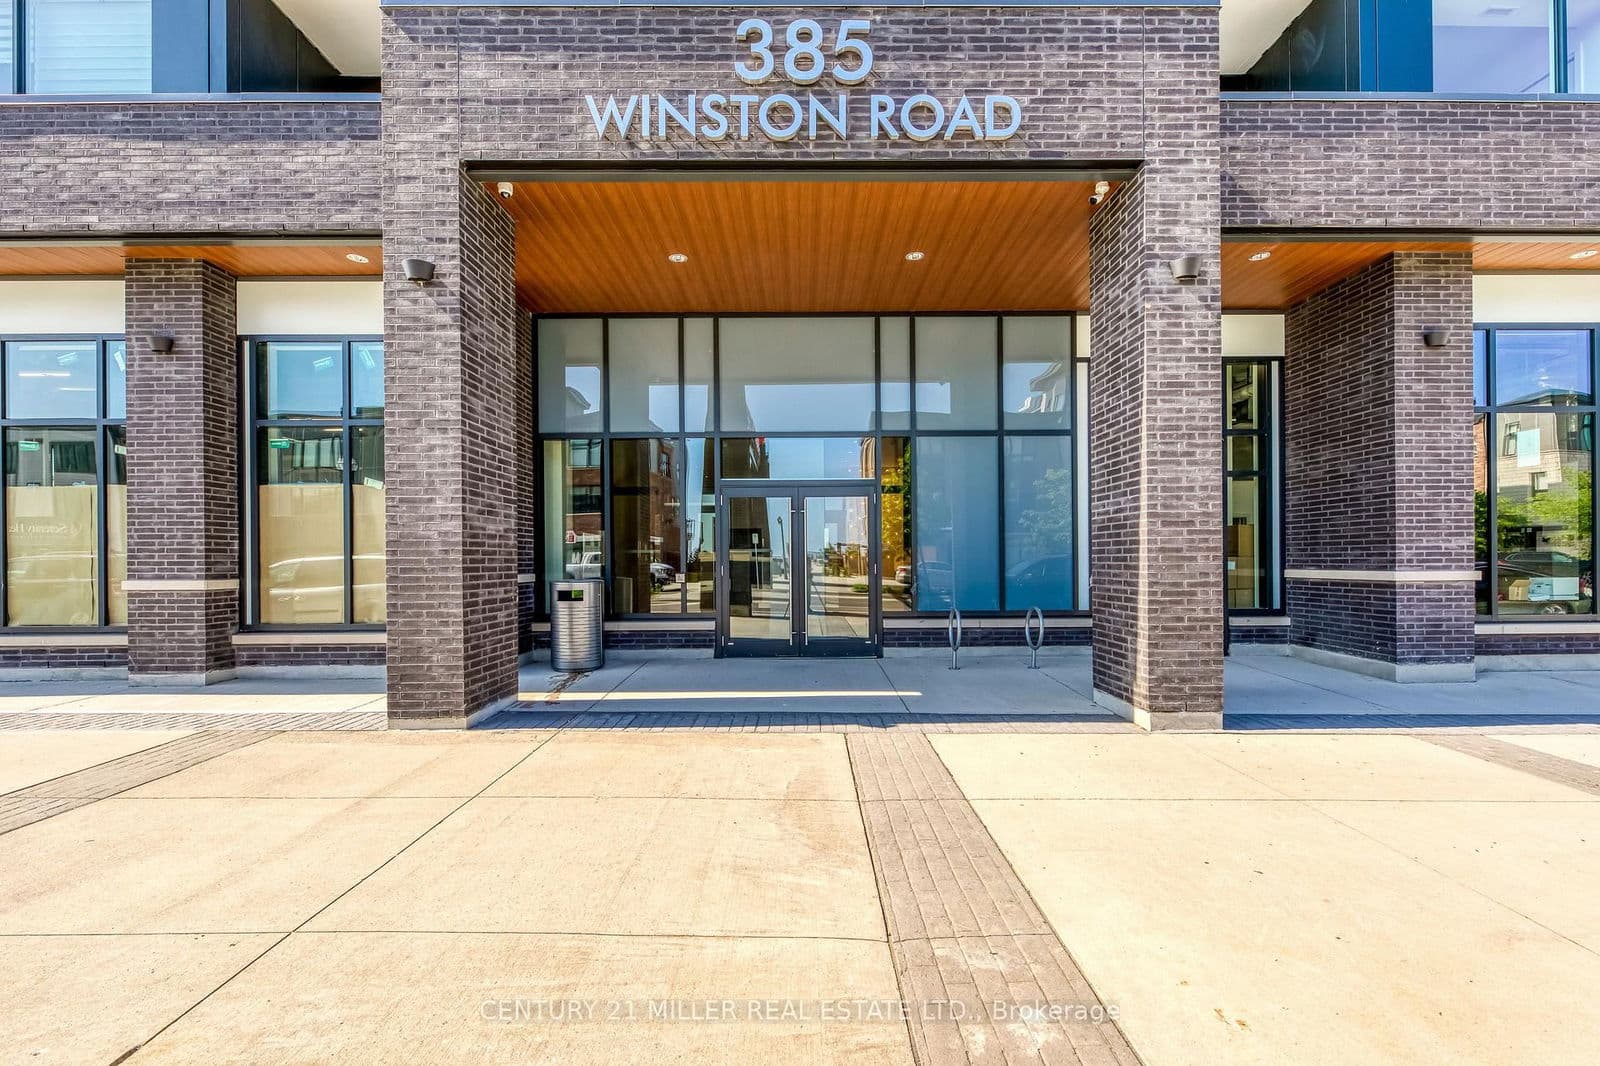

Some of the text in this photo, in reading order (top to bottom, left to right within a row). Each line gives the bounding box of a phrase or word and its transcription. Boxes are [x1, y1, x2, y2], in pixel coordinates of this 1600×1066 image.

[734, 18, 874, 85] 385
[585, 93, 1022, 141] WINSTON ROAD
